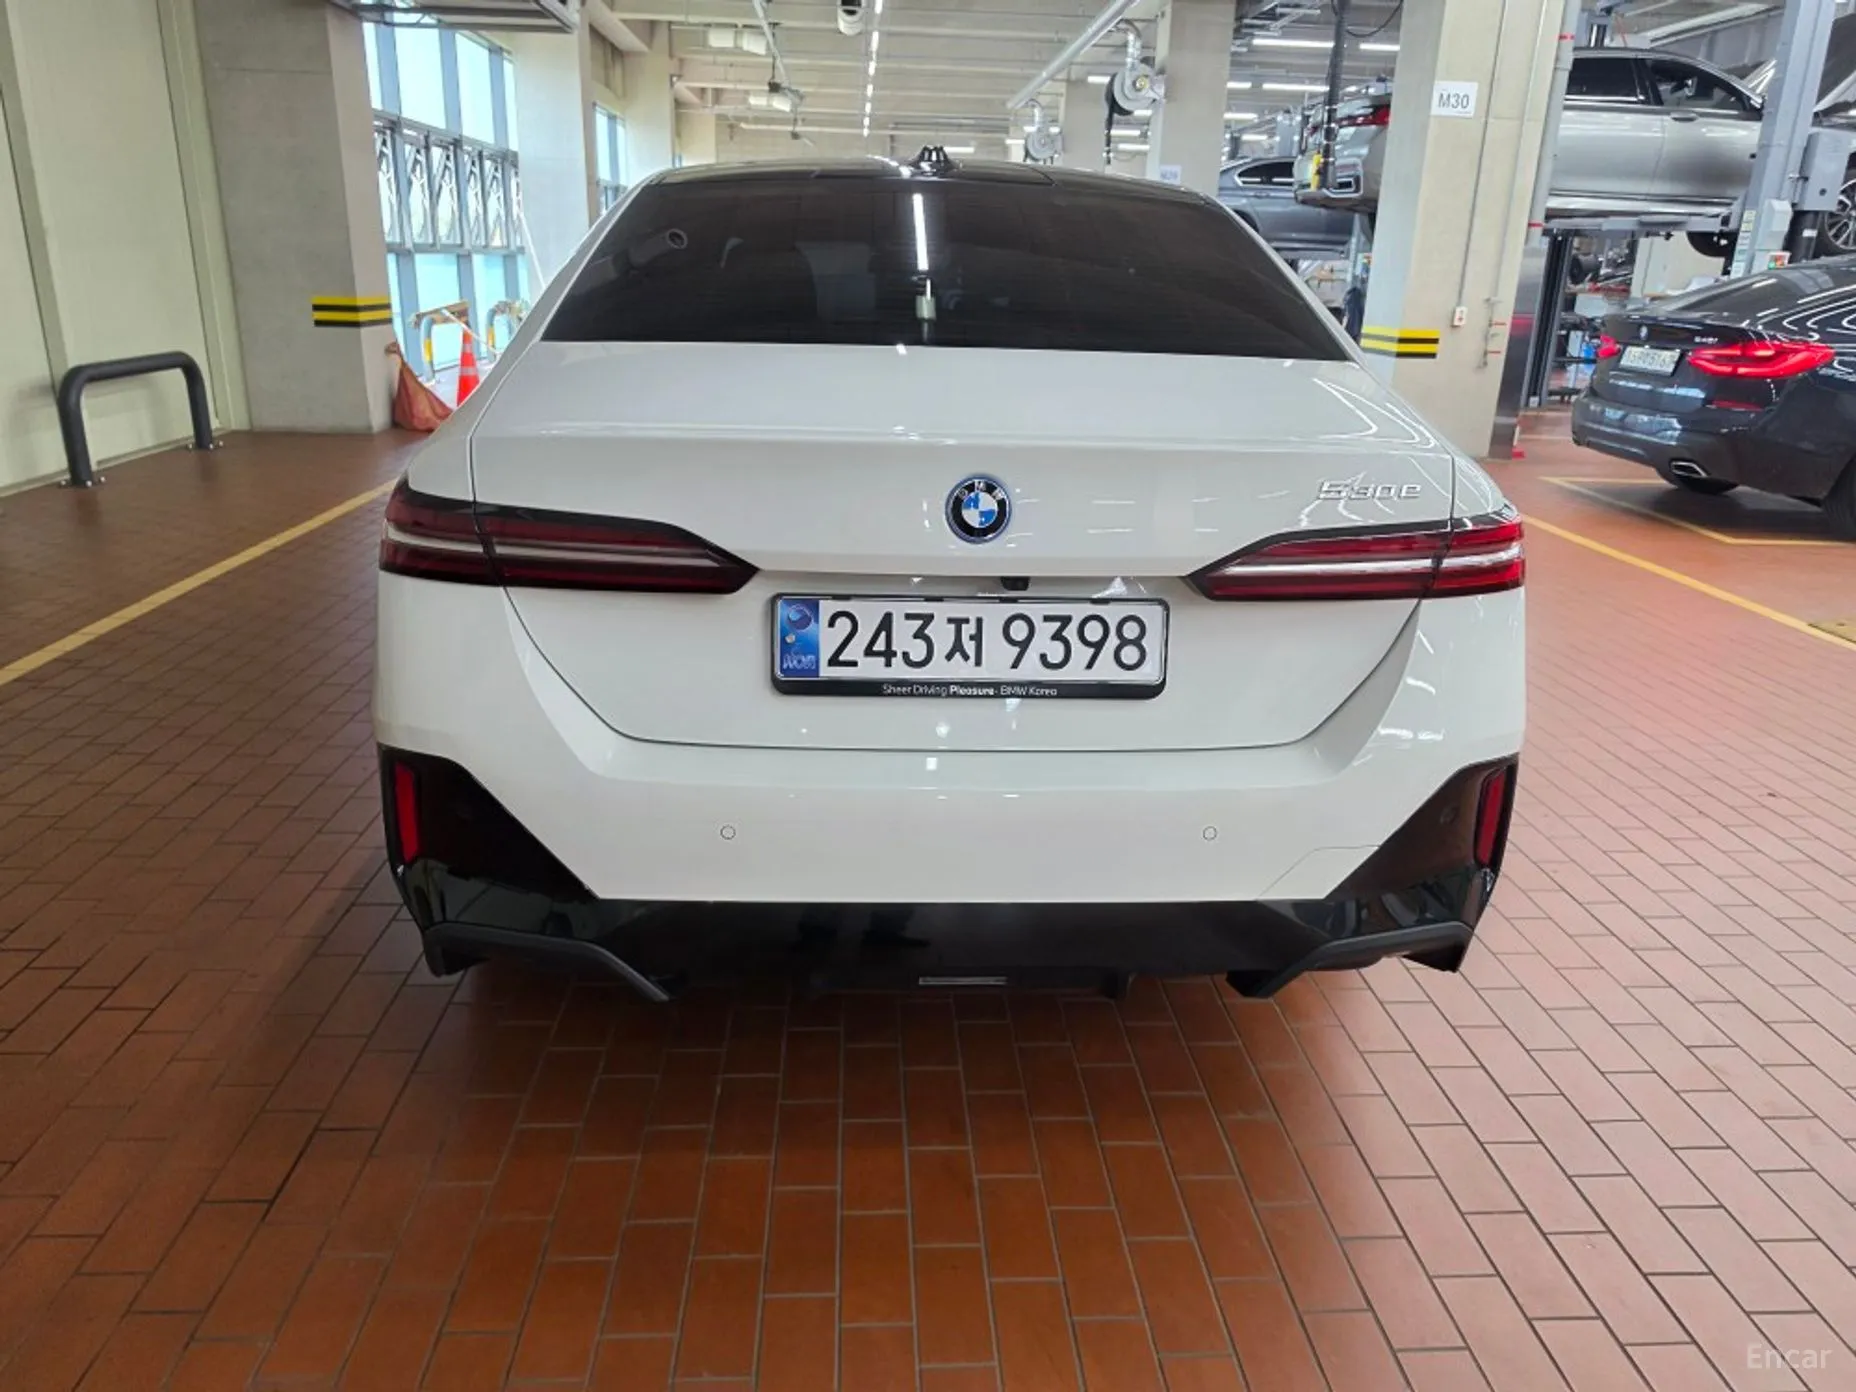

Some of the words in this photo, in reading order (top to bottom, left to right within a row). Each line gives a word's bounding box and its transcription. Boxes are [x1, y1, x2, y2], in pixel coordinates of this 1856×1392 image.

[1438, 92, 1470, 109] M30
[827, 610, 984, 669] 243저
[1002, 612, 1147, 671] 9398
[882, 683, 912, 695] Sheer
[913, 684, 949, 697] Driving
[1000, 684, 1028, 696] BMW
[1029, 685, 1058, 697] Korea
